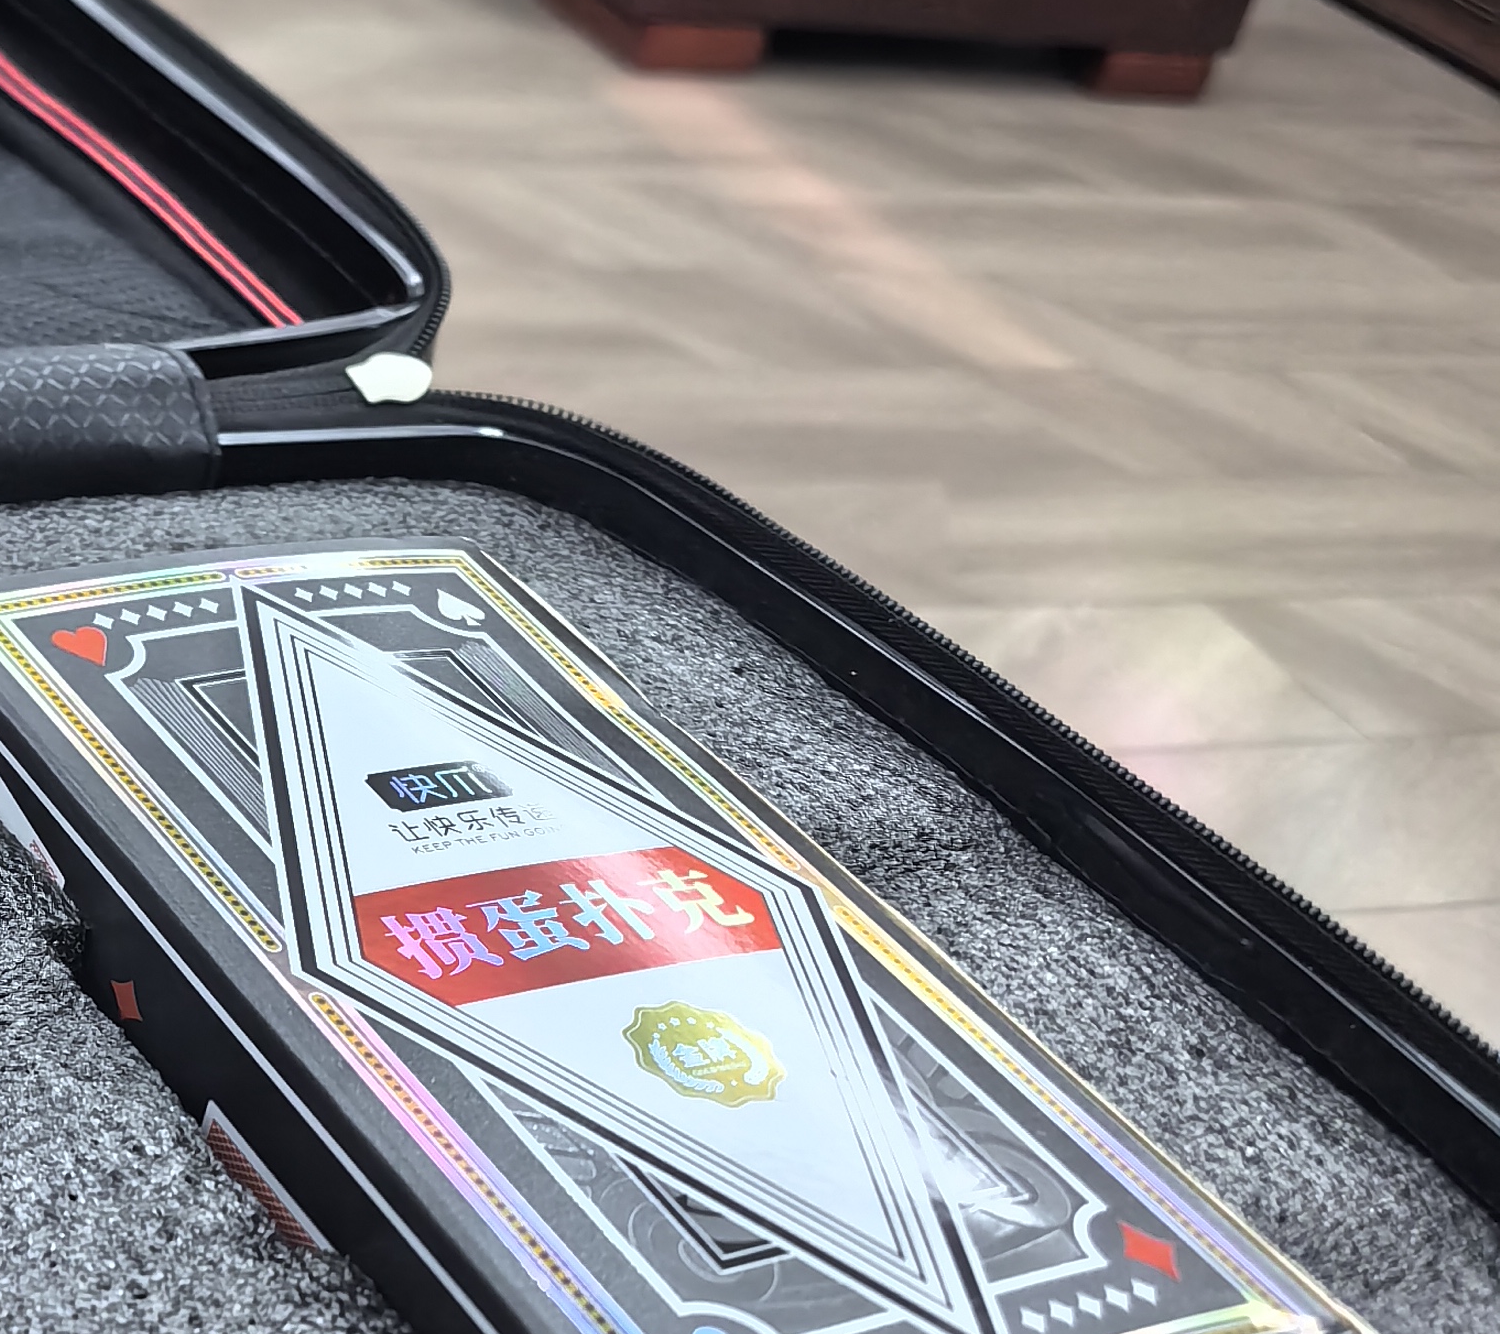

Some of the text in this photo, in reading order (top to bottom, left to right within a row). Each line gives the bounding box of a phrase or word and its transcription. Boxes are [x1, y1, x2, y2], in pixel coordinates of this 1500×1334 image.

[411, 840, 453, 855] KEEP
[453, 835, 489, 848] THE
[490, 830, 521, 843] FUN
[380, 867, 756, 981] 掼蛋扑克
